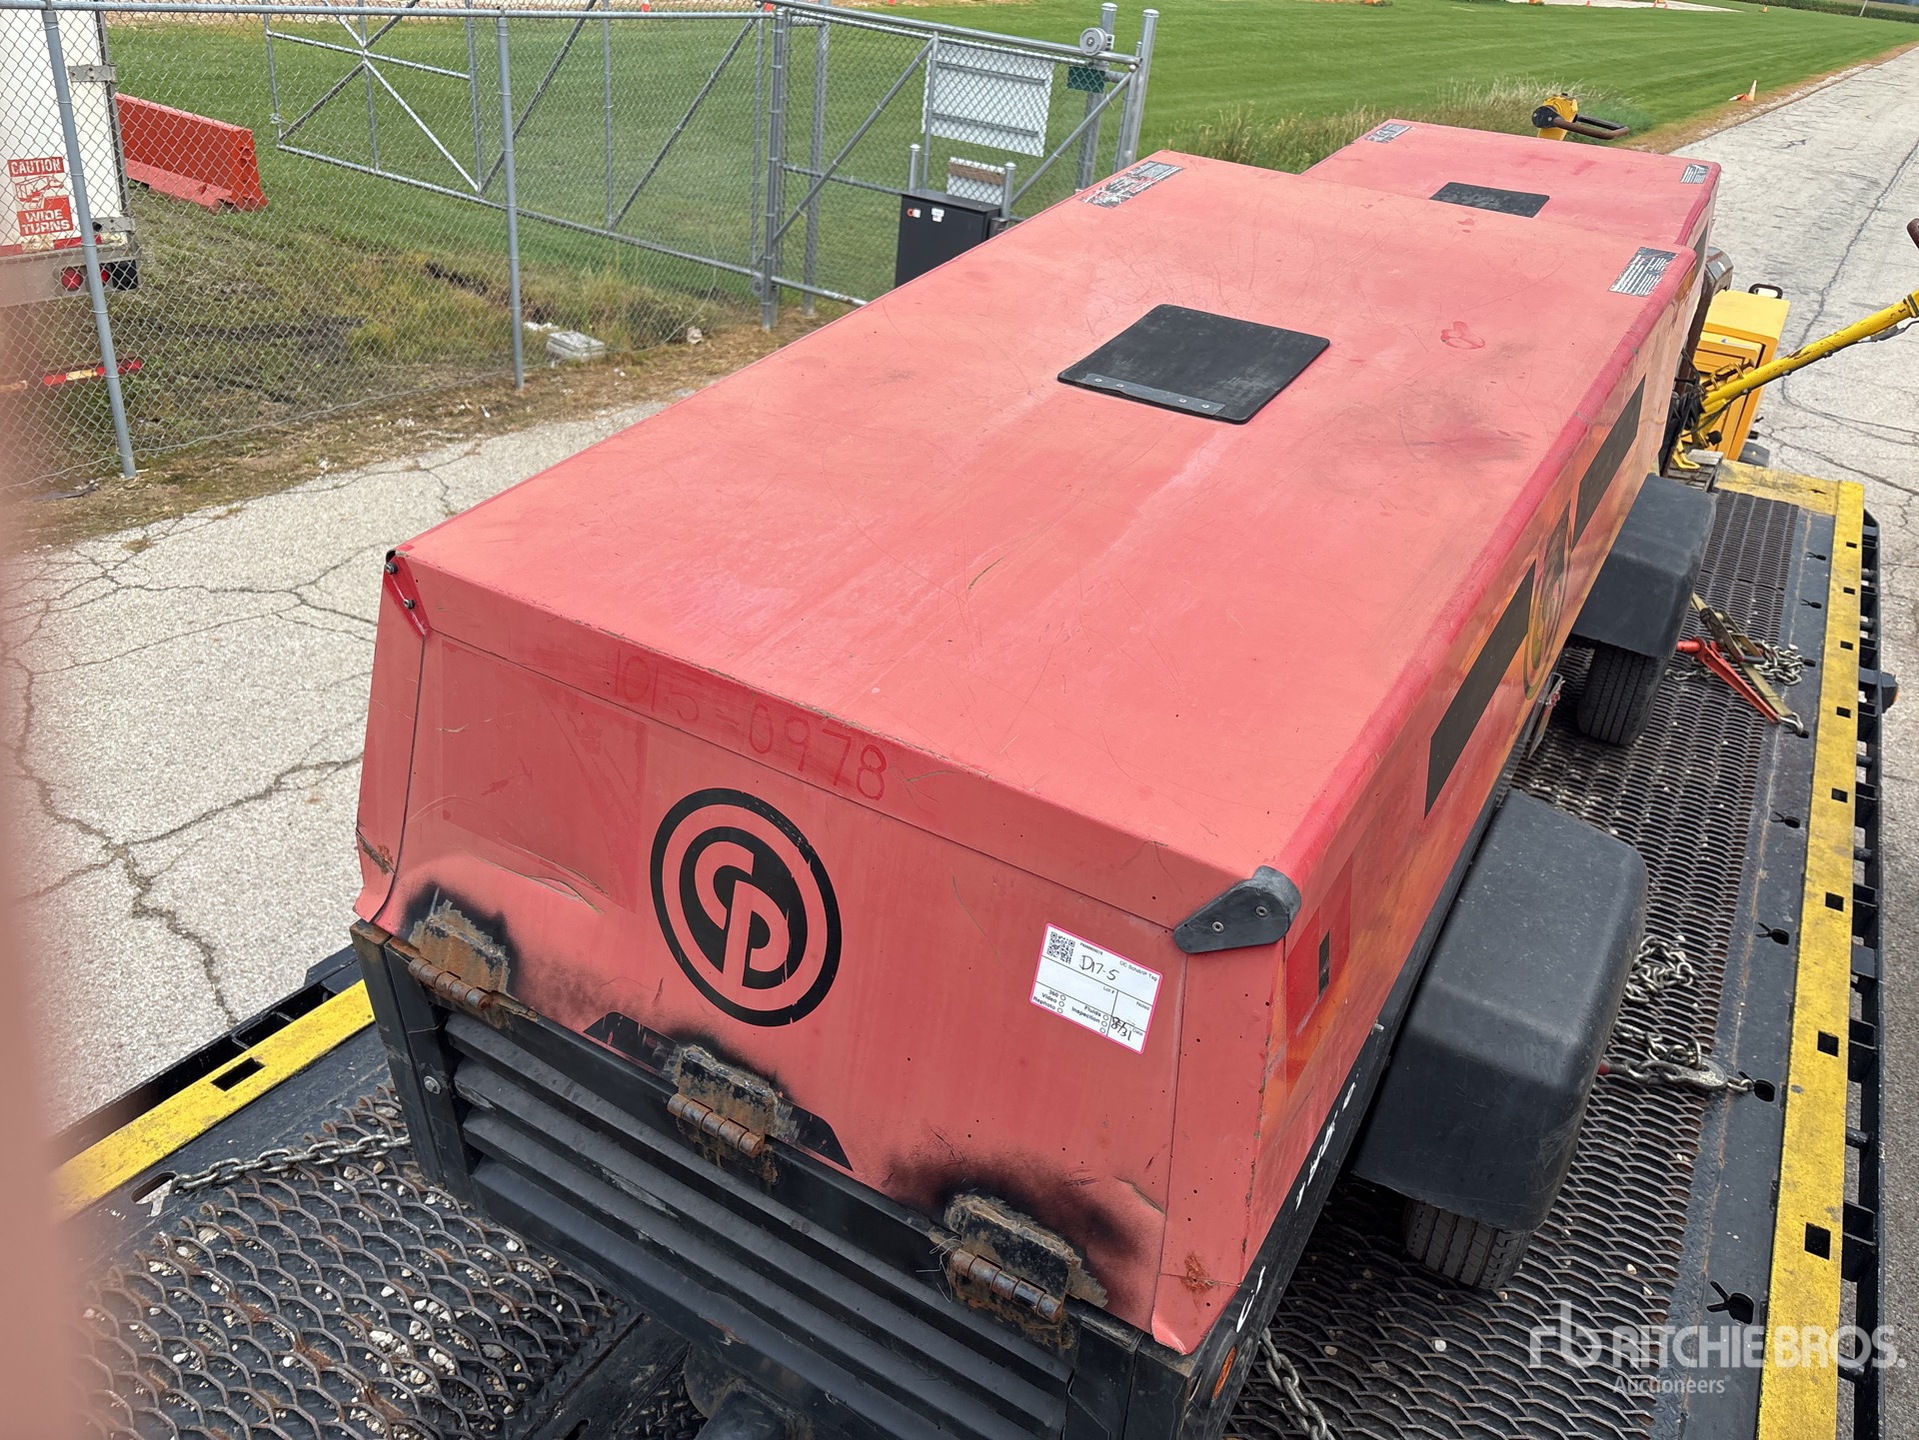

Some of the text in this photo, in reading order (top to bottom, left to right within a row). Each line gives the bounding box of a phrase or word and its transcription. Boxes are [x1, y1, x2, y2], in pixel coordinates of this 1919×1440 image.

[10, 158, 62, 175] CAUTION
[25, 209, 64, 222] WIDE
[22, 220, 70, 235] TURNS
[1041, 992, 1058, 1003] Video
[1049, 990, 1059, 998] 360
[1071, 1006, 1100, 1023] Inspection
[1084, 1005, 1101, 1017] Fluids
